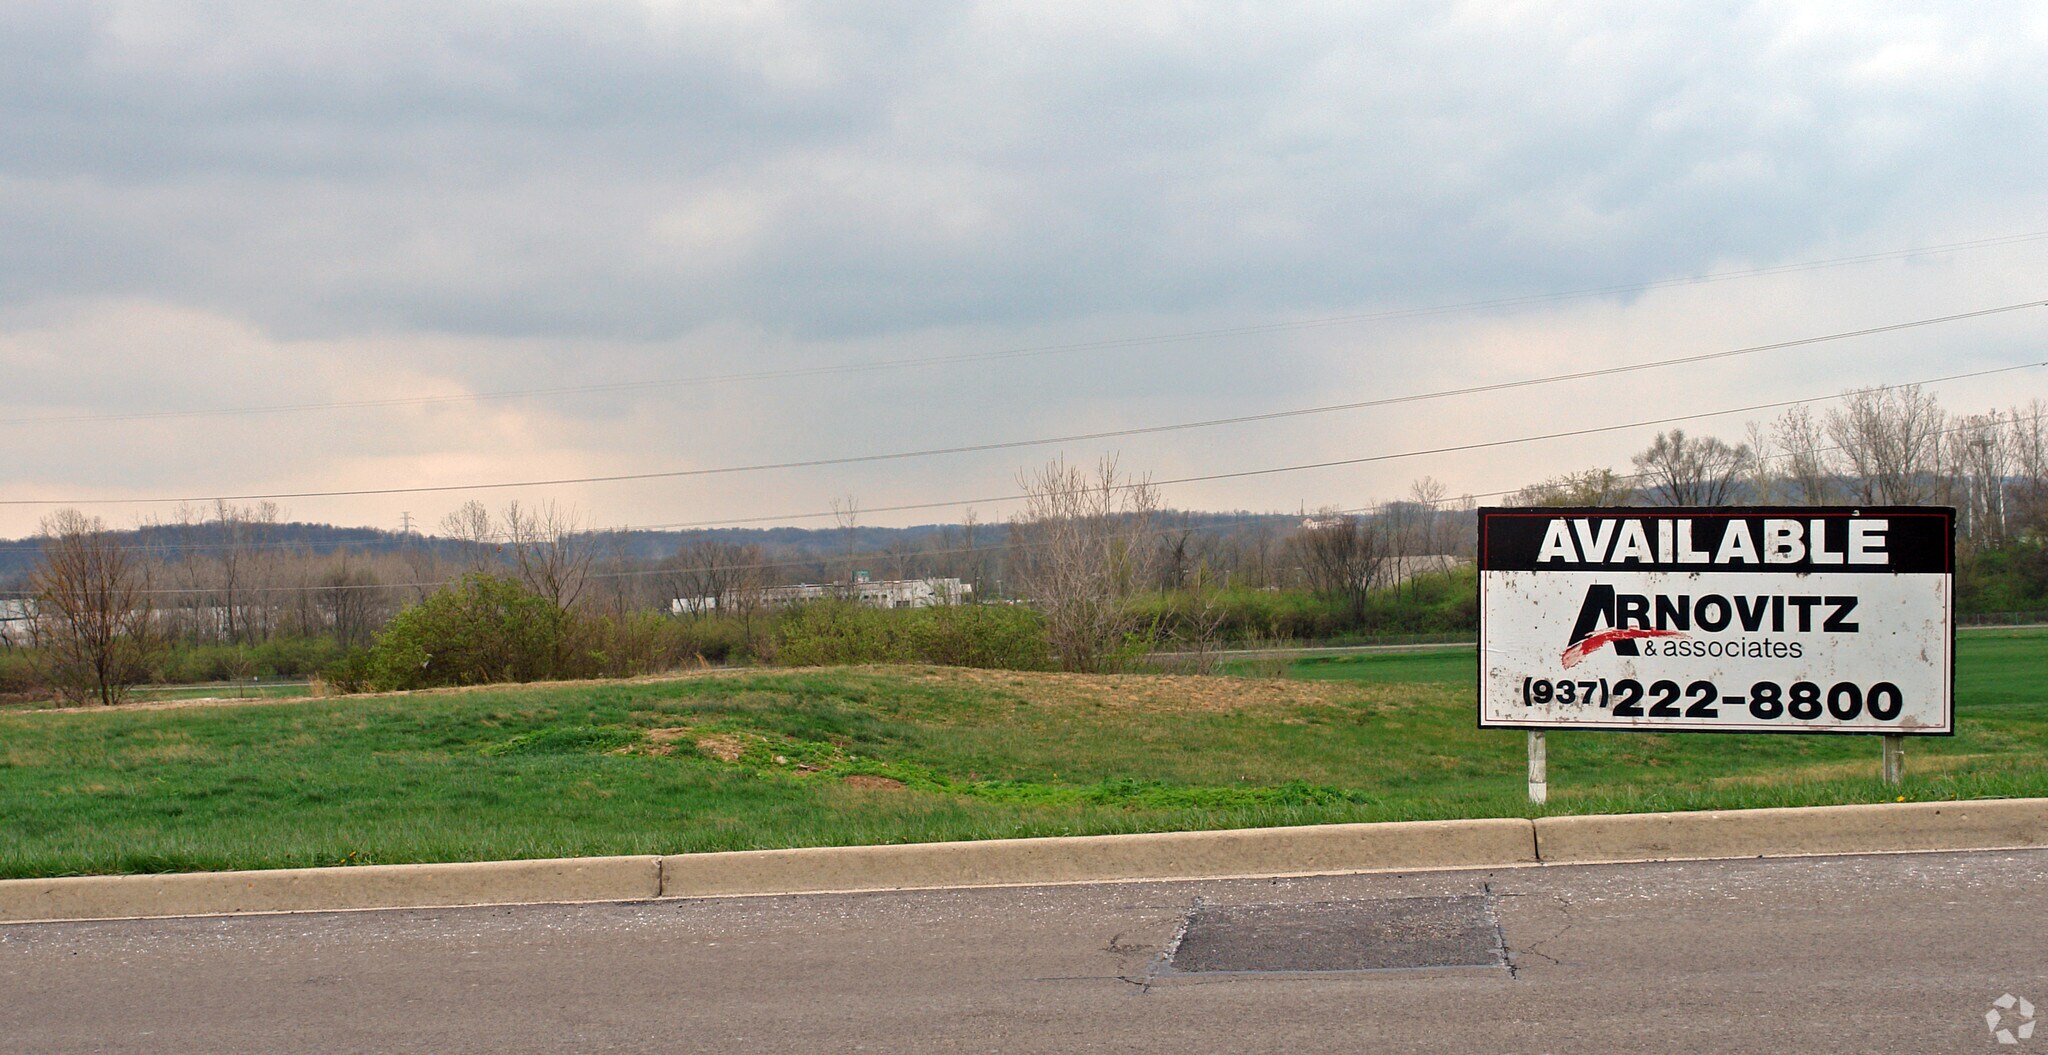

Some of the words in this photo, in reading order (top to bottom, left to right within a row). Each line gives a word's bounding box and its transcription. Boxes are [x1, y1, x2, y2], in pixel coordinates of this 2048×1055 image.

[1537, 518, 1889, 565] AVAILABLE
[1568, 584, 1859, 656] ARNOVITZ
[1644, 639, 1657, 657] &
[1663, 636, 1803, 658] associates
